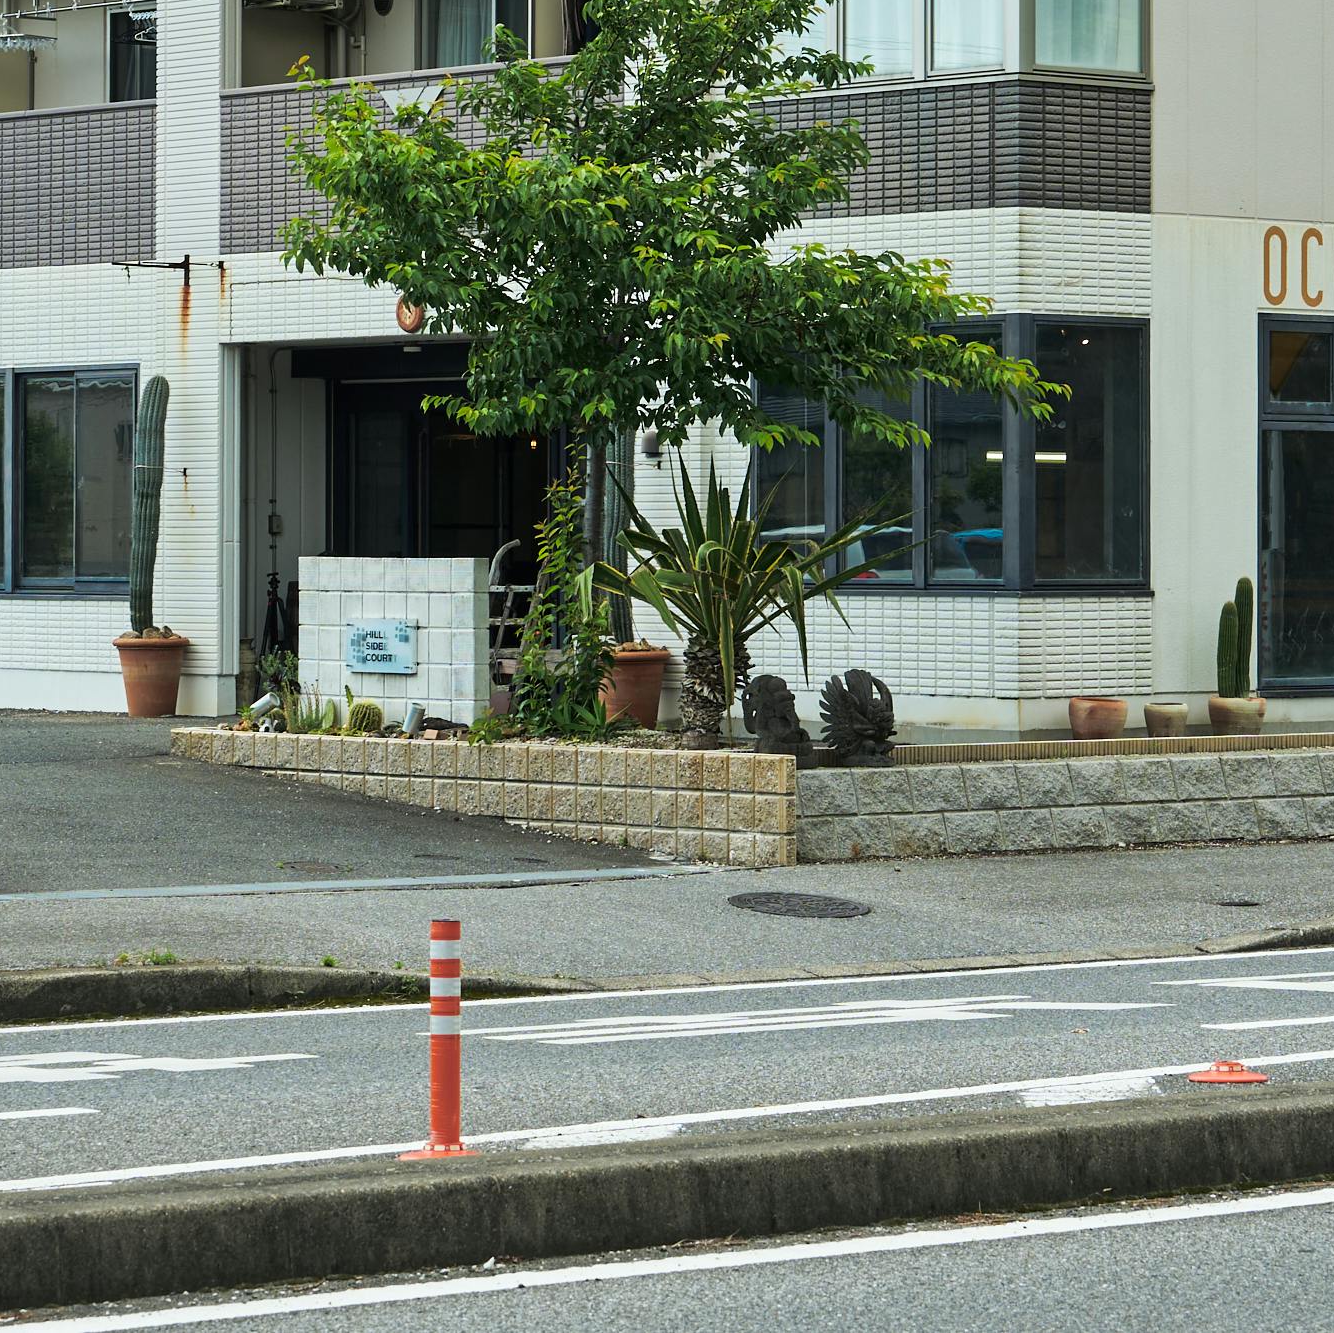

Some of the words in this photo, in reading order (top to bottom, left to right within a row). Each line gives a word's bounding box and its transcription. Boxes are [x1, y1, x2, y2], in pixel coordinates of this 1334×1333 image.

[366, 630, 383, 639] HILL
[366, 642, 384, 651] SIDE
[366, 654, 393, 662] COURT
